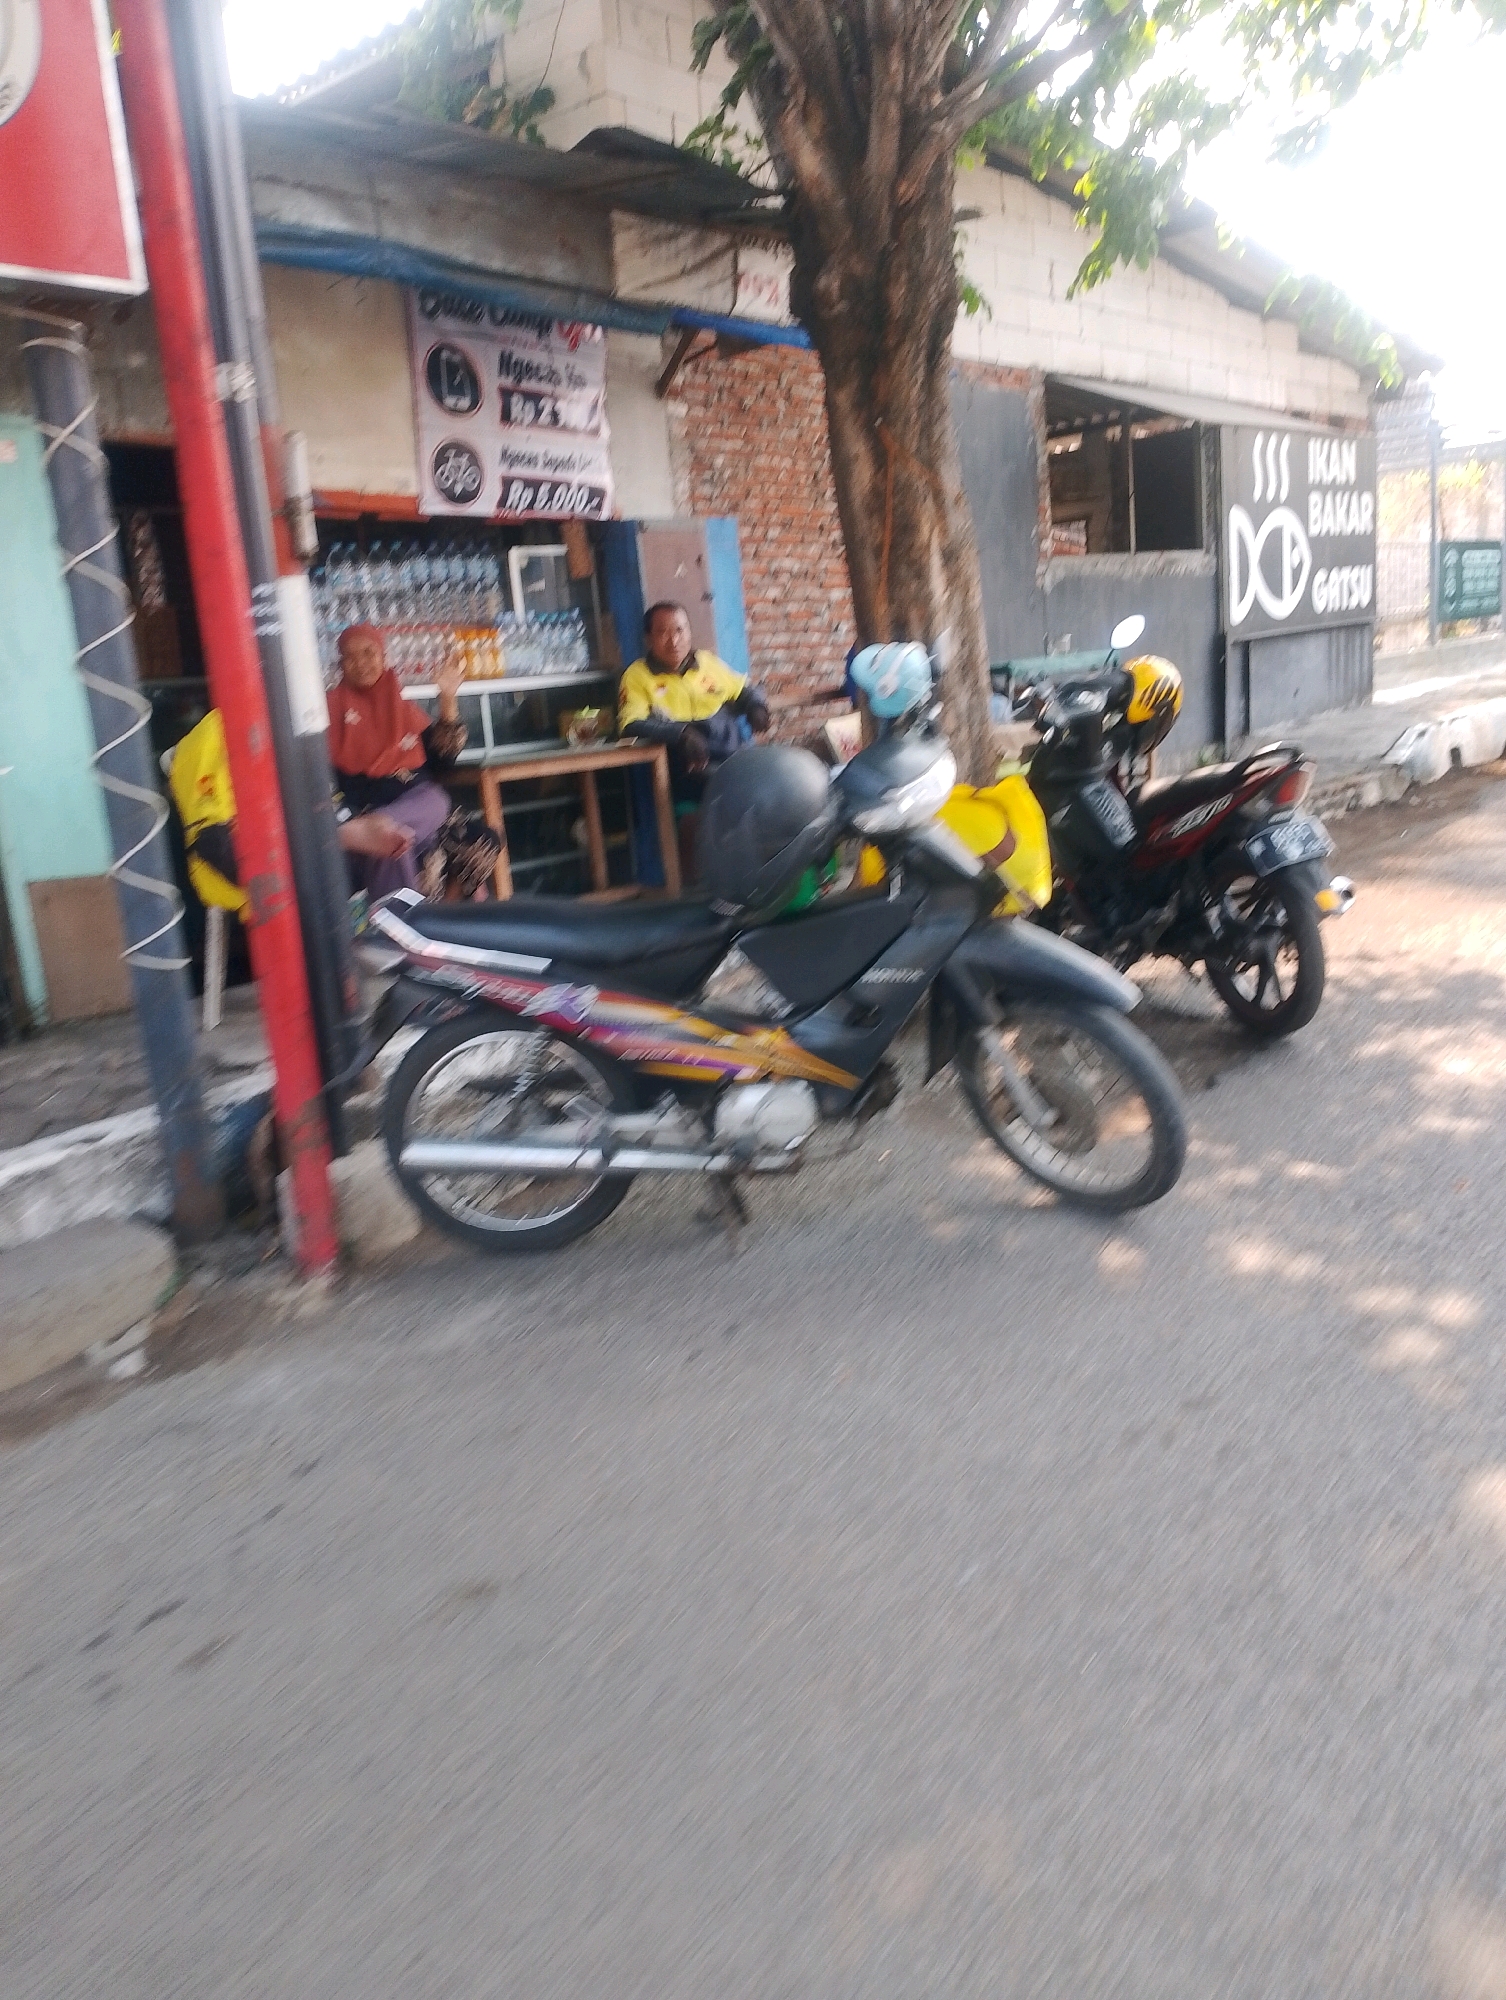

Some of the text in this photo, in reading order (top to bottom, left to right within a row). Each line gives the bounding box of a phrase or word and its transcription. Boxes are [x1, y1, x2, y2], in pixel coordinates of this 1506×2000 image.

[1307, 437, 1358, 486] IKAN
[504, 479, 536, 517] Rp
[1307, 489, 1375, 538] BAKAR
[1311, 564, 1374, 615] GATSU
